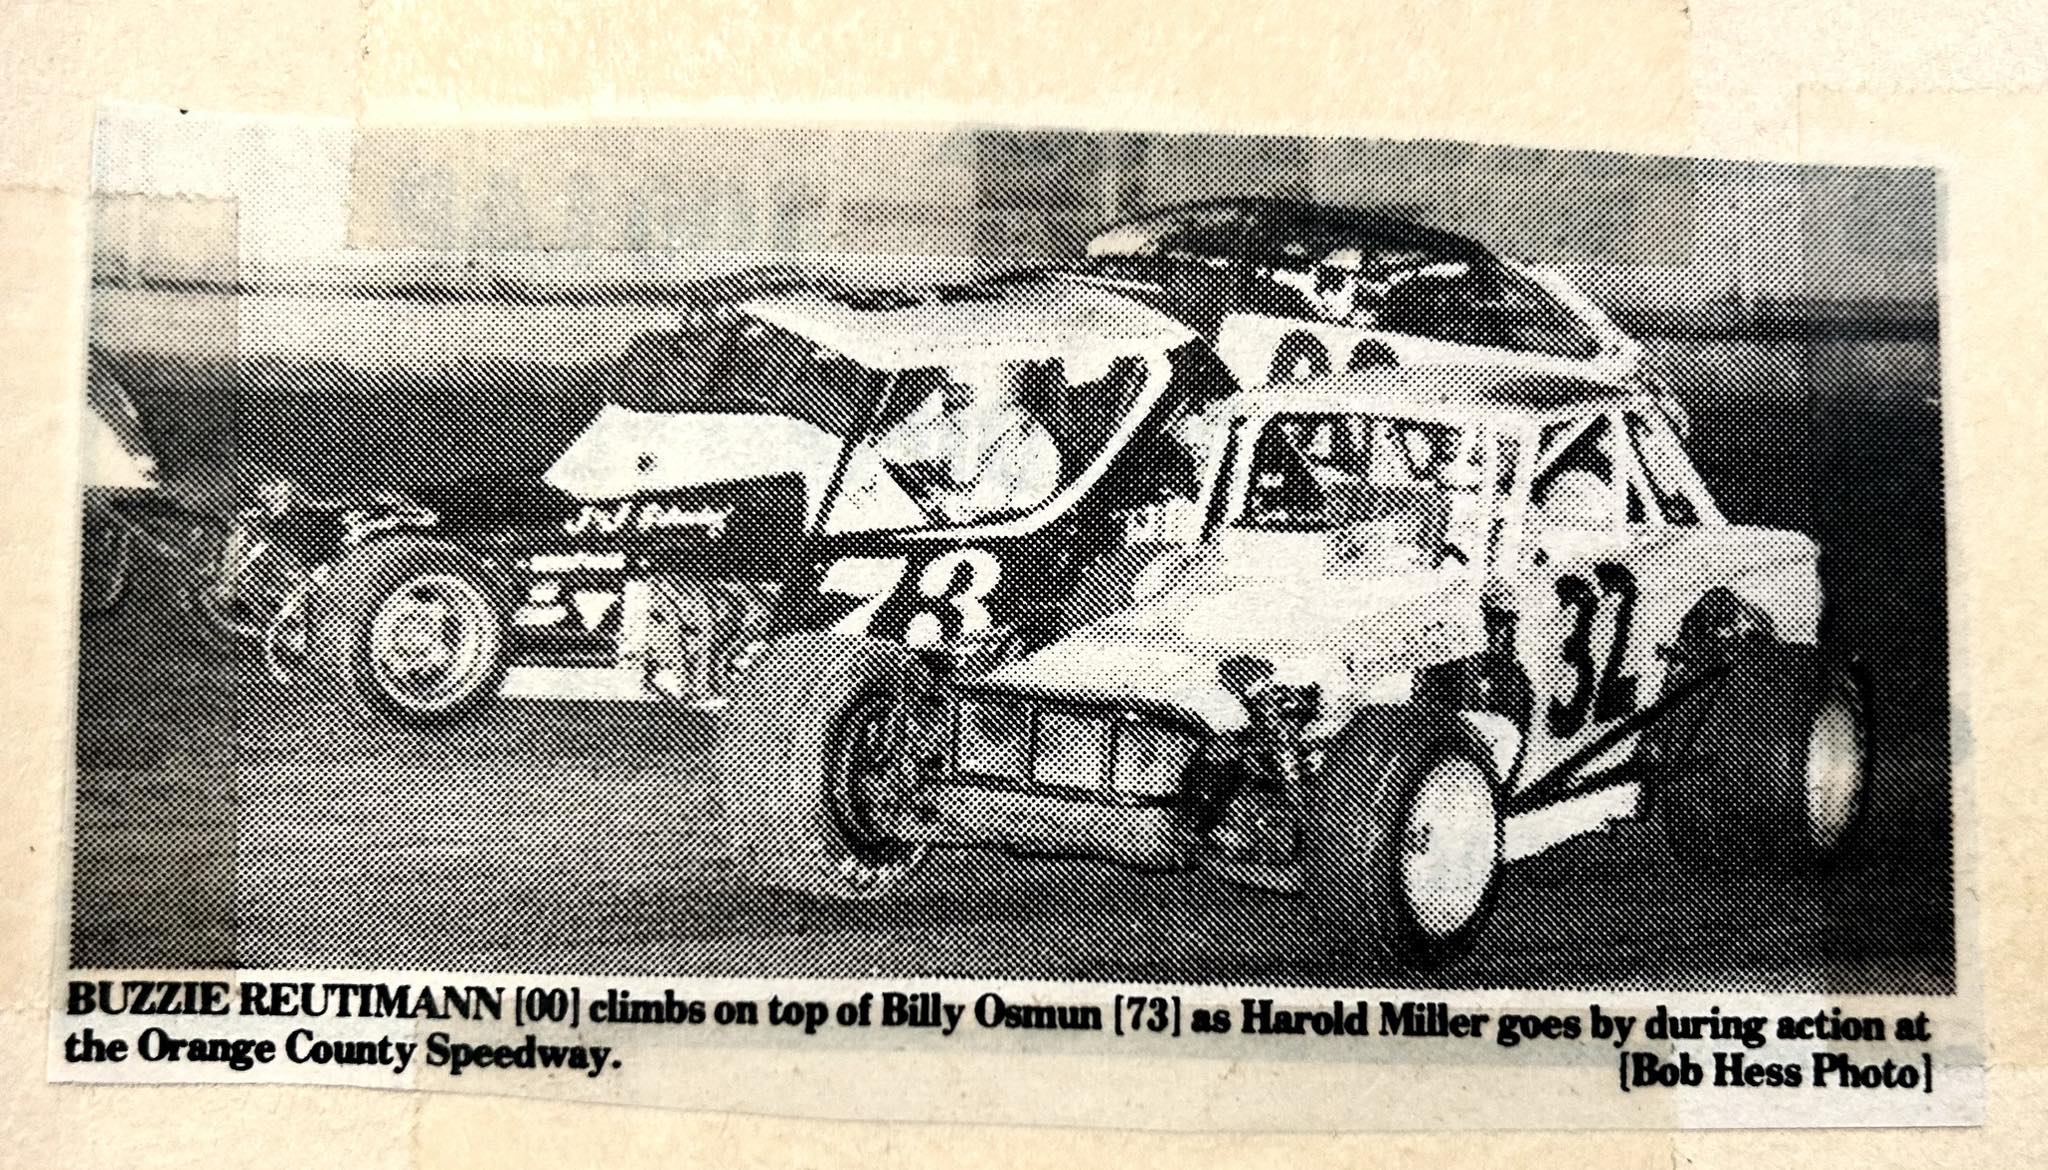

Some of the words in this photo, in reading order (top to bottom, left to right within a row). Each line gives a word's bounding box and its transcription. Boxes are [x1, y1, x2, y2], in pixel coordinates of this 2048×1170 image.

[817, 549, 1000, 650] 73
[1547, 561, 1638, 739] 32
[67, 981, 229, 1016] BUZZIE
[239, 982, 505, 1021] REUTIMANN
[516, 986, 579, 1028] [00]
[589, 989, 706, 1025] climbs
[714, 1002, 758, 1026] on
[768, 996, 829, 1034] top
[836, 993, 873, 1027] of
[882, 992, 965, 1036] Billy
[975, 993, 1102, 1031] Osmun
[1115, 995, 1180, 1037] [73]
[1191, 1008, 1231, 1034] as
[1241, 999, 1369, 1037] Harold
[1379, 1002, 1490, 1039] Miller
[1497, 1014, 1581, 1048] goes
[1590, 1005, 1636, 1049] by
[1645, 1005, 1767, 1050] during
[1777, 1009, 1886, 1042] action
[1895, 1011, 1931, 1042] at
[65, 1028, 128, 1063] the
[138, 1028, 275, 1072] Orange
[286, 1029, 417, 1075] County
[427, 1032, 622, 1077] Speedway.
[1620, 1052, 1703, 1093] [Bob
[1713, 1053, 1802, 1088] Hess
[1813, 1053, 1932, 1094] Photo]
